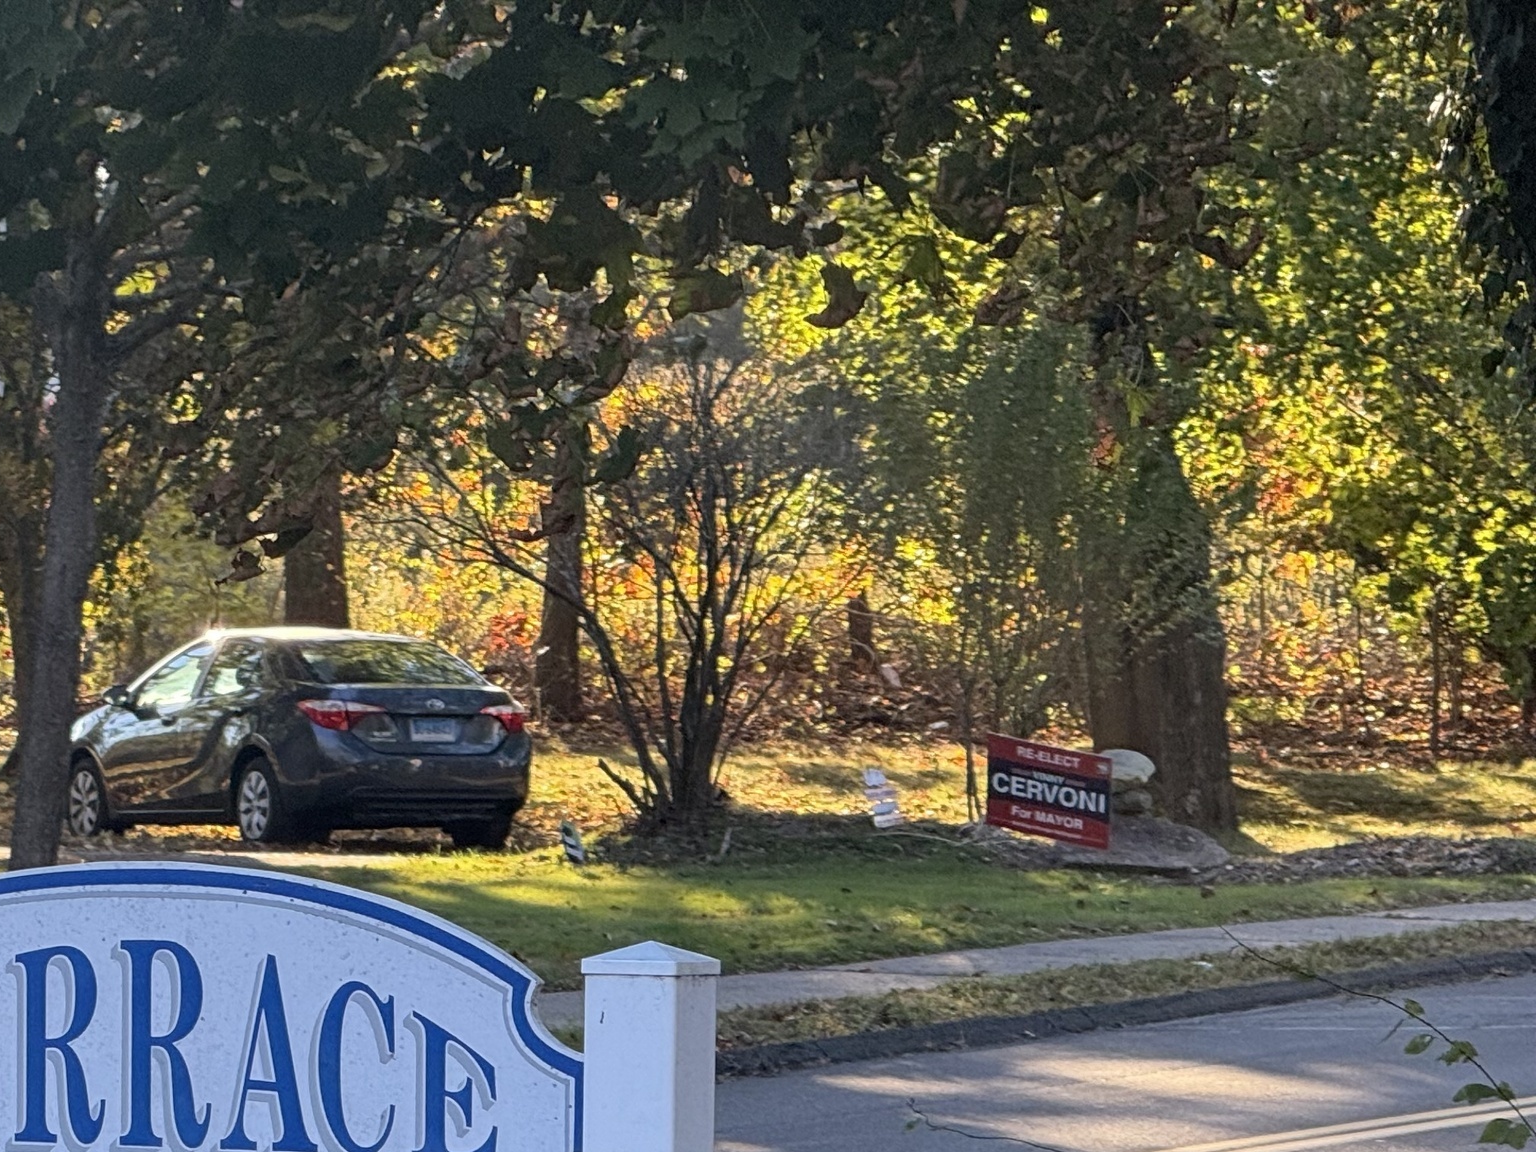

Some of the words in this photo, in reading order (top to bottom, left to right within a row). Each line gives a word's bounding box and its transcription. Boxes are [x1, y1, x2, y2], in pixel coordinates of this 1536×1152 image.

[1016, 746, 1081, 769] RE-ELECT
[992, 772, 1106, 813] CERVONI
[1011, 805, 1032, 819] For
[1034, 811, 1084, 830] MAYOR
